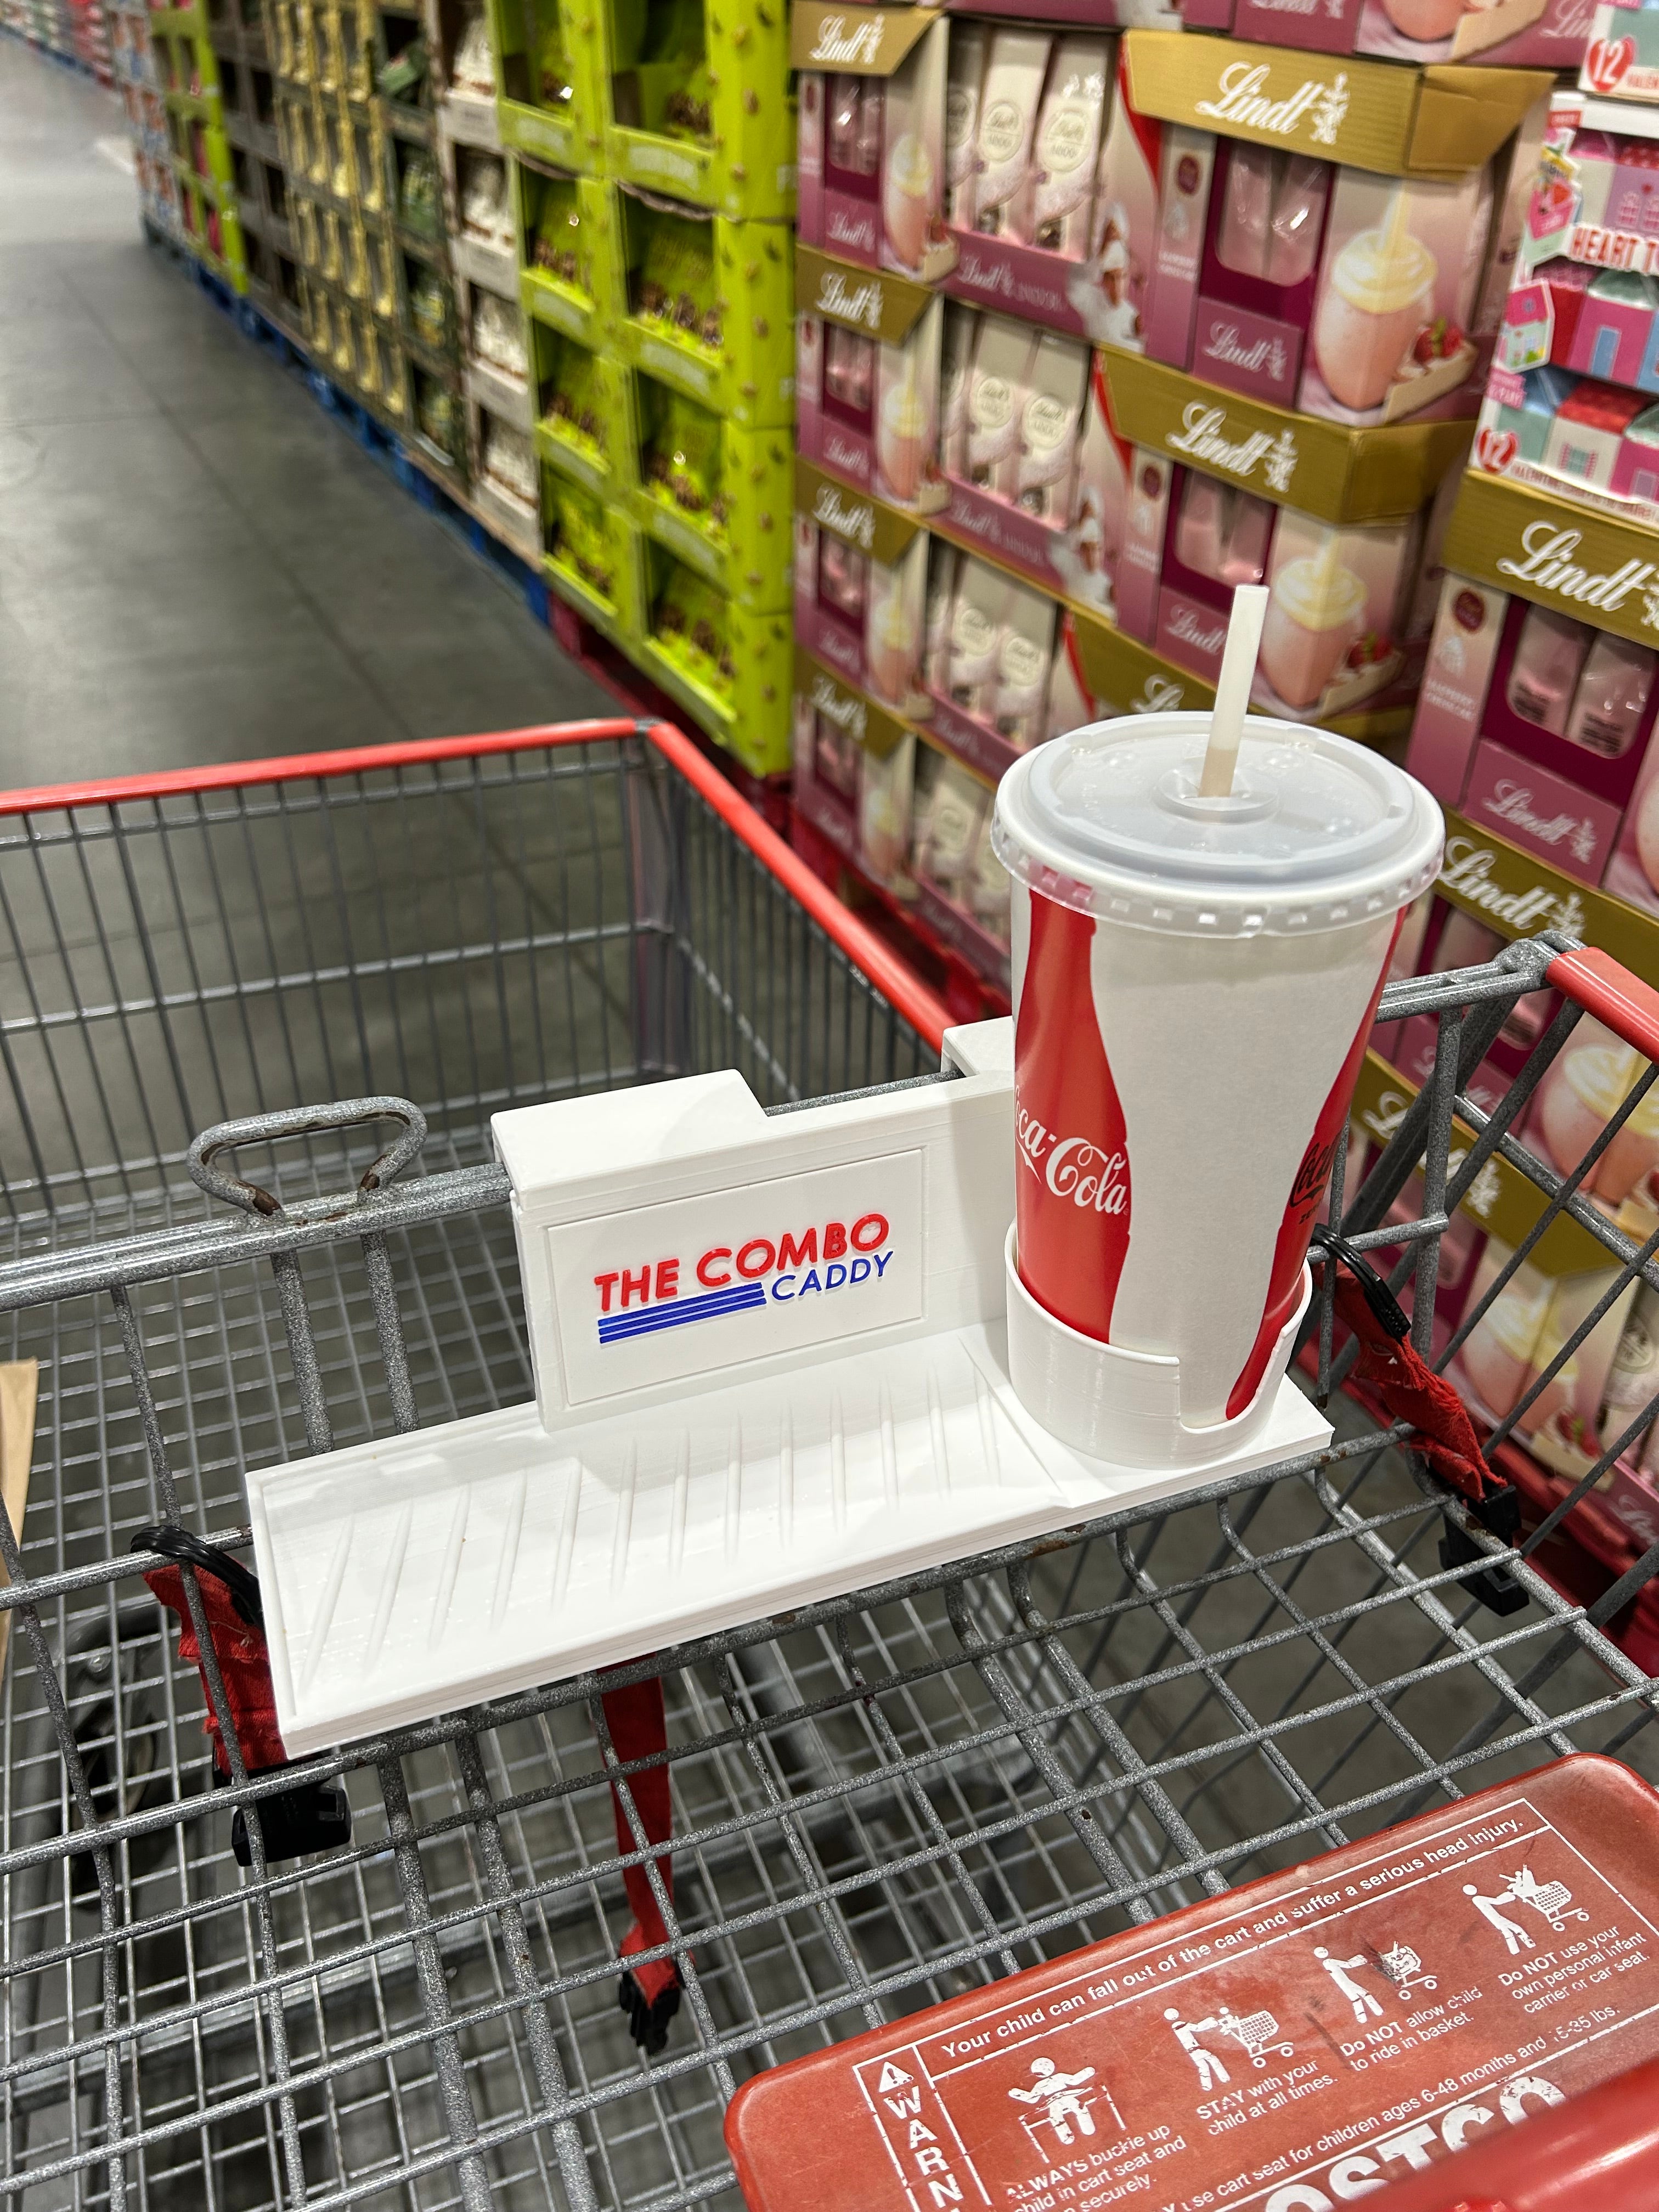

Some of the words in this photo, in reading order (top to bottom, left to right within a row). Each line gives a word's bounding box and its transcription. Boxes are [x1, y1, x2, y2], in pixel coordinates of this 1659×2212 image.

[810, 14, 871, 62] Lindt
[1593, 40, 1623, 83] 12
[1194, 61, 1324, 134] Lindt
[1570, 227, 1640, 269] HEART
[814, 272, 873, 323] Lindt
[1203, 320, 1269, 373] Lindt
[1166, 400, 1276, 477] Lindt
[1497, 520, 1657, 612] Lindt
[1483, 779, 1578, 845] Lindt
[1435, 836, 1560, 930] Lindt
[594, 1258, 680, 1311] THE
[696, 1213, 889, 1287] COMBO
[771, 1251, 894, 1301] CADDY
[941, 2030, 991, 2058] Your
[996, 2008, 1046, 2038] child
[1049, 1994, 1086, 2016] can
[1087, 1978, 1119, 2001] fall
[1123, 1964, 1156, 1987] out
[1159, 1953, 1177, 1972] of
[1179, 1942, 1212, 1963] the
[1215, 1923, 1251, 1949] cart
[1252, 1910, 1288, 1935] and
[1290, 1891, 1341, 1919] suffer
[1346, 1884, 1358, 1897] a
[1359, 1858, 1425, 1890] serious
[1424, 1838, 1469, 1864] head
[1467, 1817, 1523, 1846] injury.
[1498, 1971, 1523, 1987] Do
[1523, 1953, 1558, 1976] NOT
[1560, 1942, 1588, 1959] use
[1587, 1926, 1621, 1948] your
[1512, 1982, 1544, 2000] own
[1543, 1951, 1605, 1989] personal
[1602, 1931, 1647, 1956] infant
[1524, 1988, 1570, 2013] carrier
[1572, 1978, 1588, 1991] or
[1590, 1967, 1613, 1984] car
[1614, 1950, 1650, 1972] seat.
[1340, 2039, 1365, 2057] Do
[1365, 2021, 1403, 2043] NOT
[1406, 2005, 1444, 2028] allow
[1447, 1986, 1483, 2010] child
[1351, 2057, 1369, 2072] to
[1370, 2043, 1401, 2064] ride
[1402, 2035, 1418, 2049] in
[1420, 2013, 1475, 2042] basket.
[1197, 2089, 1245, 2120] STAY
[1247, 2074, 1283, 2098] with
[1284, 2060, 1319, 2086] your
[1208, 2110, 1248, 2136] child
[1249, 2103, 1266, 2119] at
[1268, 2091, 1288, 2110] all
[1290, 2076, 1338, 2101] times.
[1217, 2173, 1251, 2196] cart
[1252, 2156, 1290, 2180] seat
[1289, 2145, 1314, 2163] for
[1317, 2116, 1380, 2151] children
[1382, 2097, 1421, 2124] ages
[1422, 2078, 1459, 2103] 6-48
[1460, 2053, 1516, 2085] months
[1517, 2036, 1547, 2058] and
[1589, 2007, 1620, 2023] lbs.
[883, 2085, 964, 2212] WARN
[1007, 2159, 1088, 2199] ALWAYS
[1148, 2125, 1171, 2141] up
[1056, 2186, 1076, 2201] in
[1078, 2169, 1113, 2192] cart
[1114, 2151, 1153, 2176] seat
[1153, 2135, 1187, 2159] and
[1080, 2173, 1158, 2212] securely.
